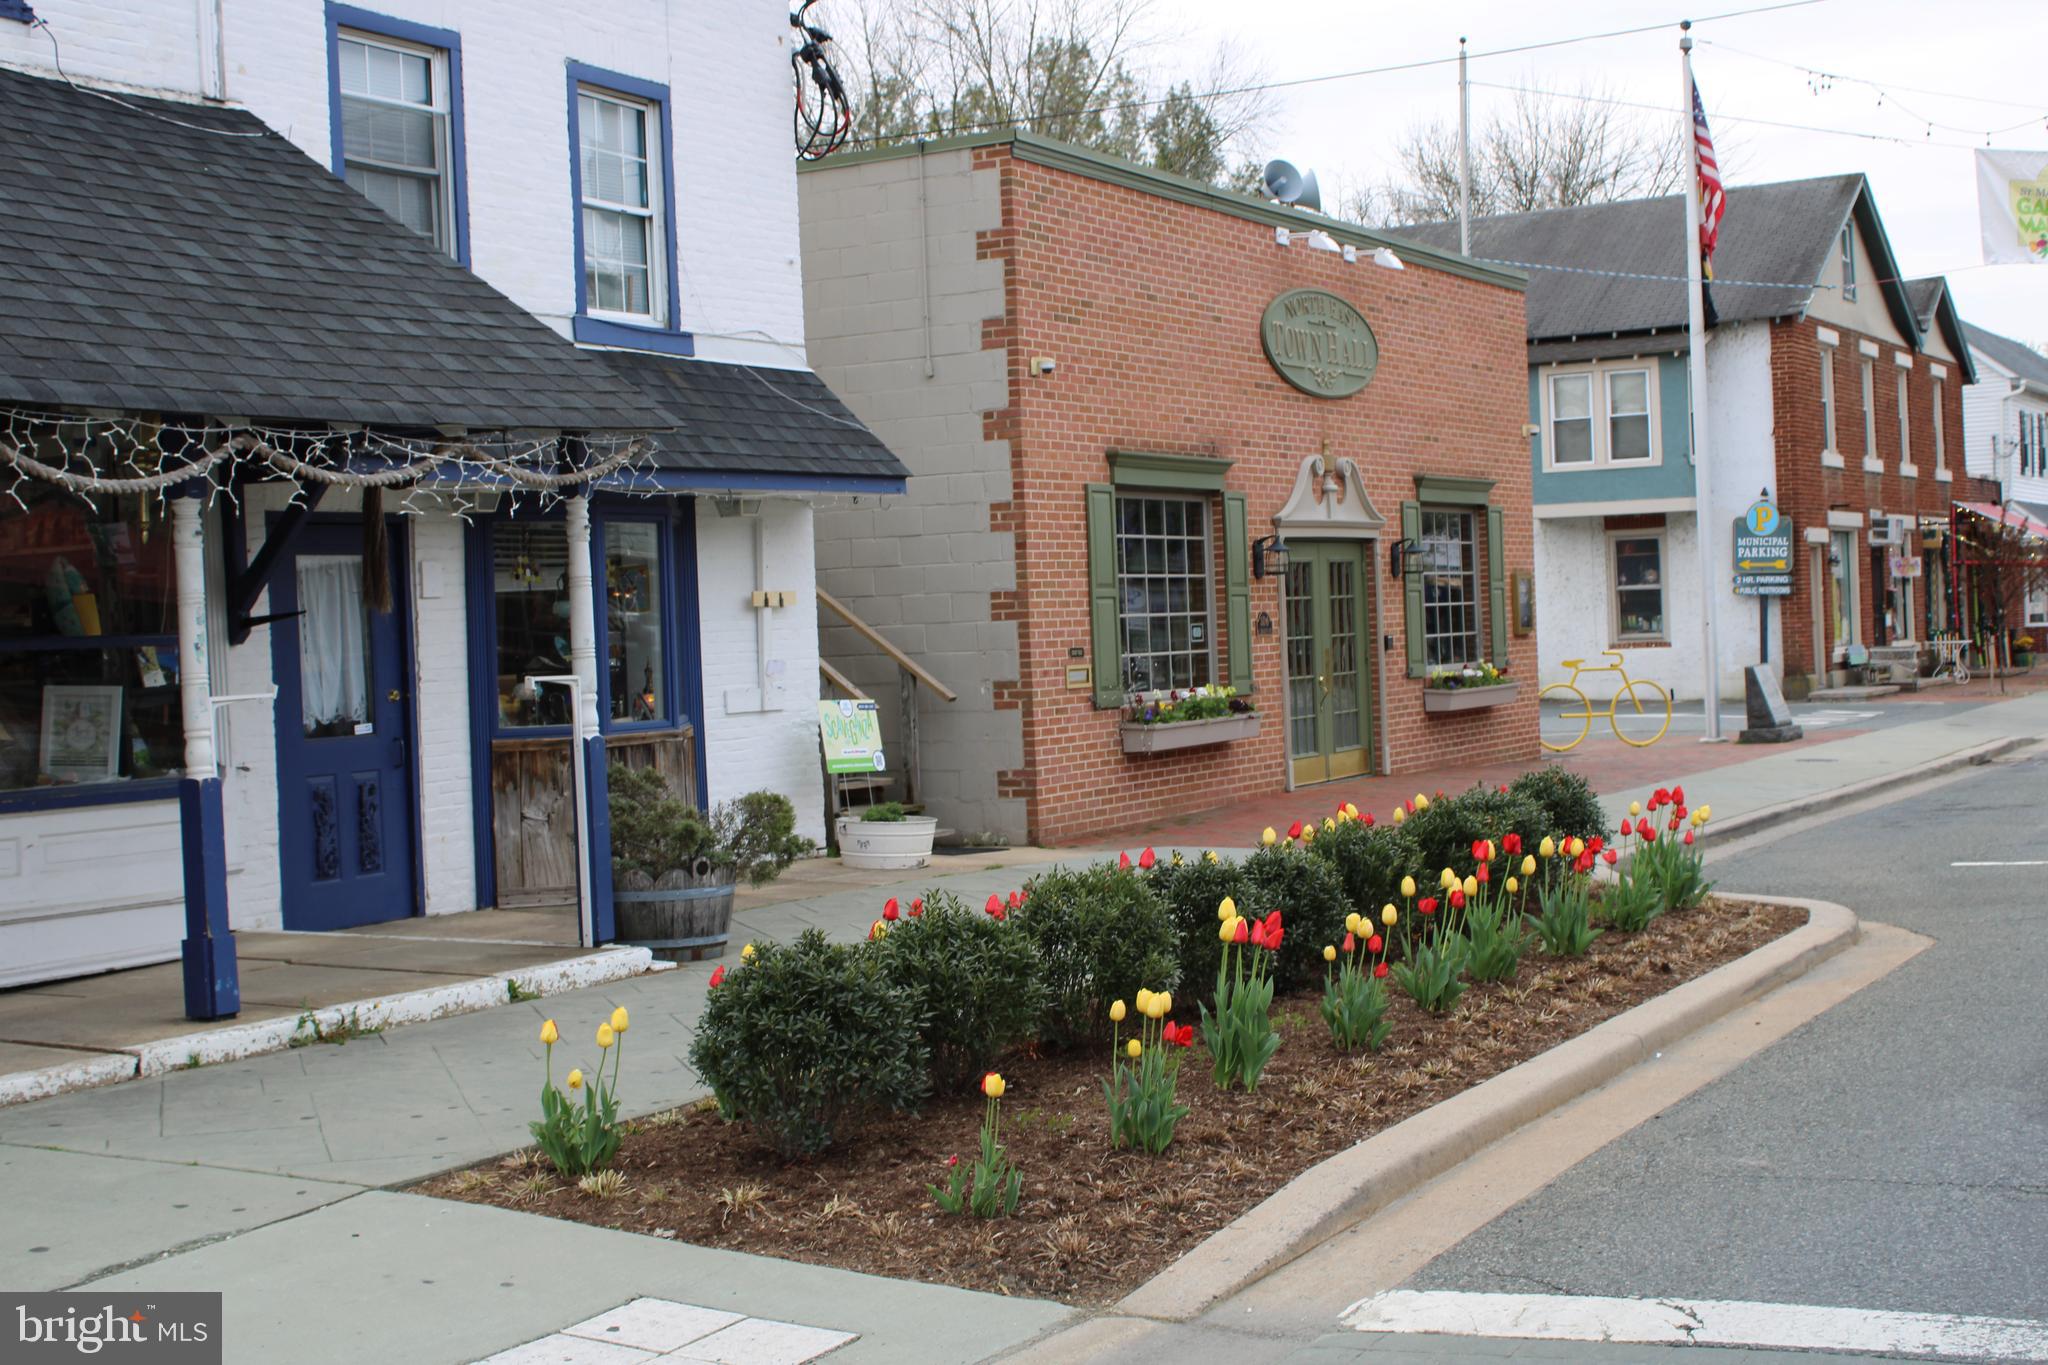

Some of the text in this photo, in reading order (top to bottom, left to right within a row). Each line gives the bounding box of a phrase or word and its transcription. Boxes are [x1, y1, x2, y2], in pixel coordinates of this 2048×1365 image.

[1284, 296, 1360, 333] NORTH EAST
[1272, 320, 1373, 370] TOWN HALL
[1754, 505, 1773, 531] P
[1737, 537, 1789, 546] MUNICIPAL
[1737, 547, 1788, 558] PARKING
[1756, 576, 1789, 584] PARKING
